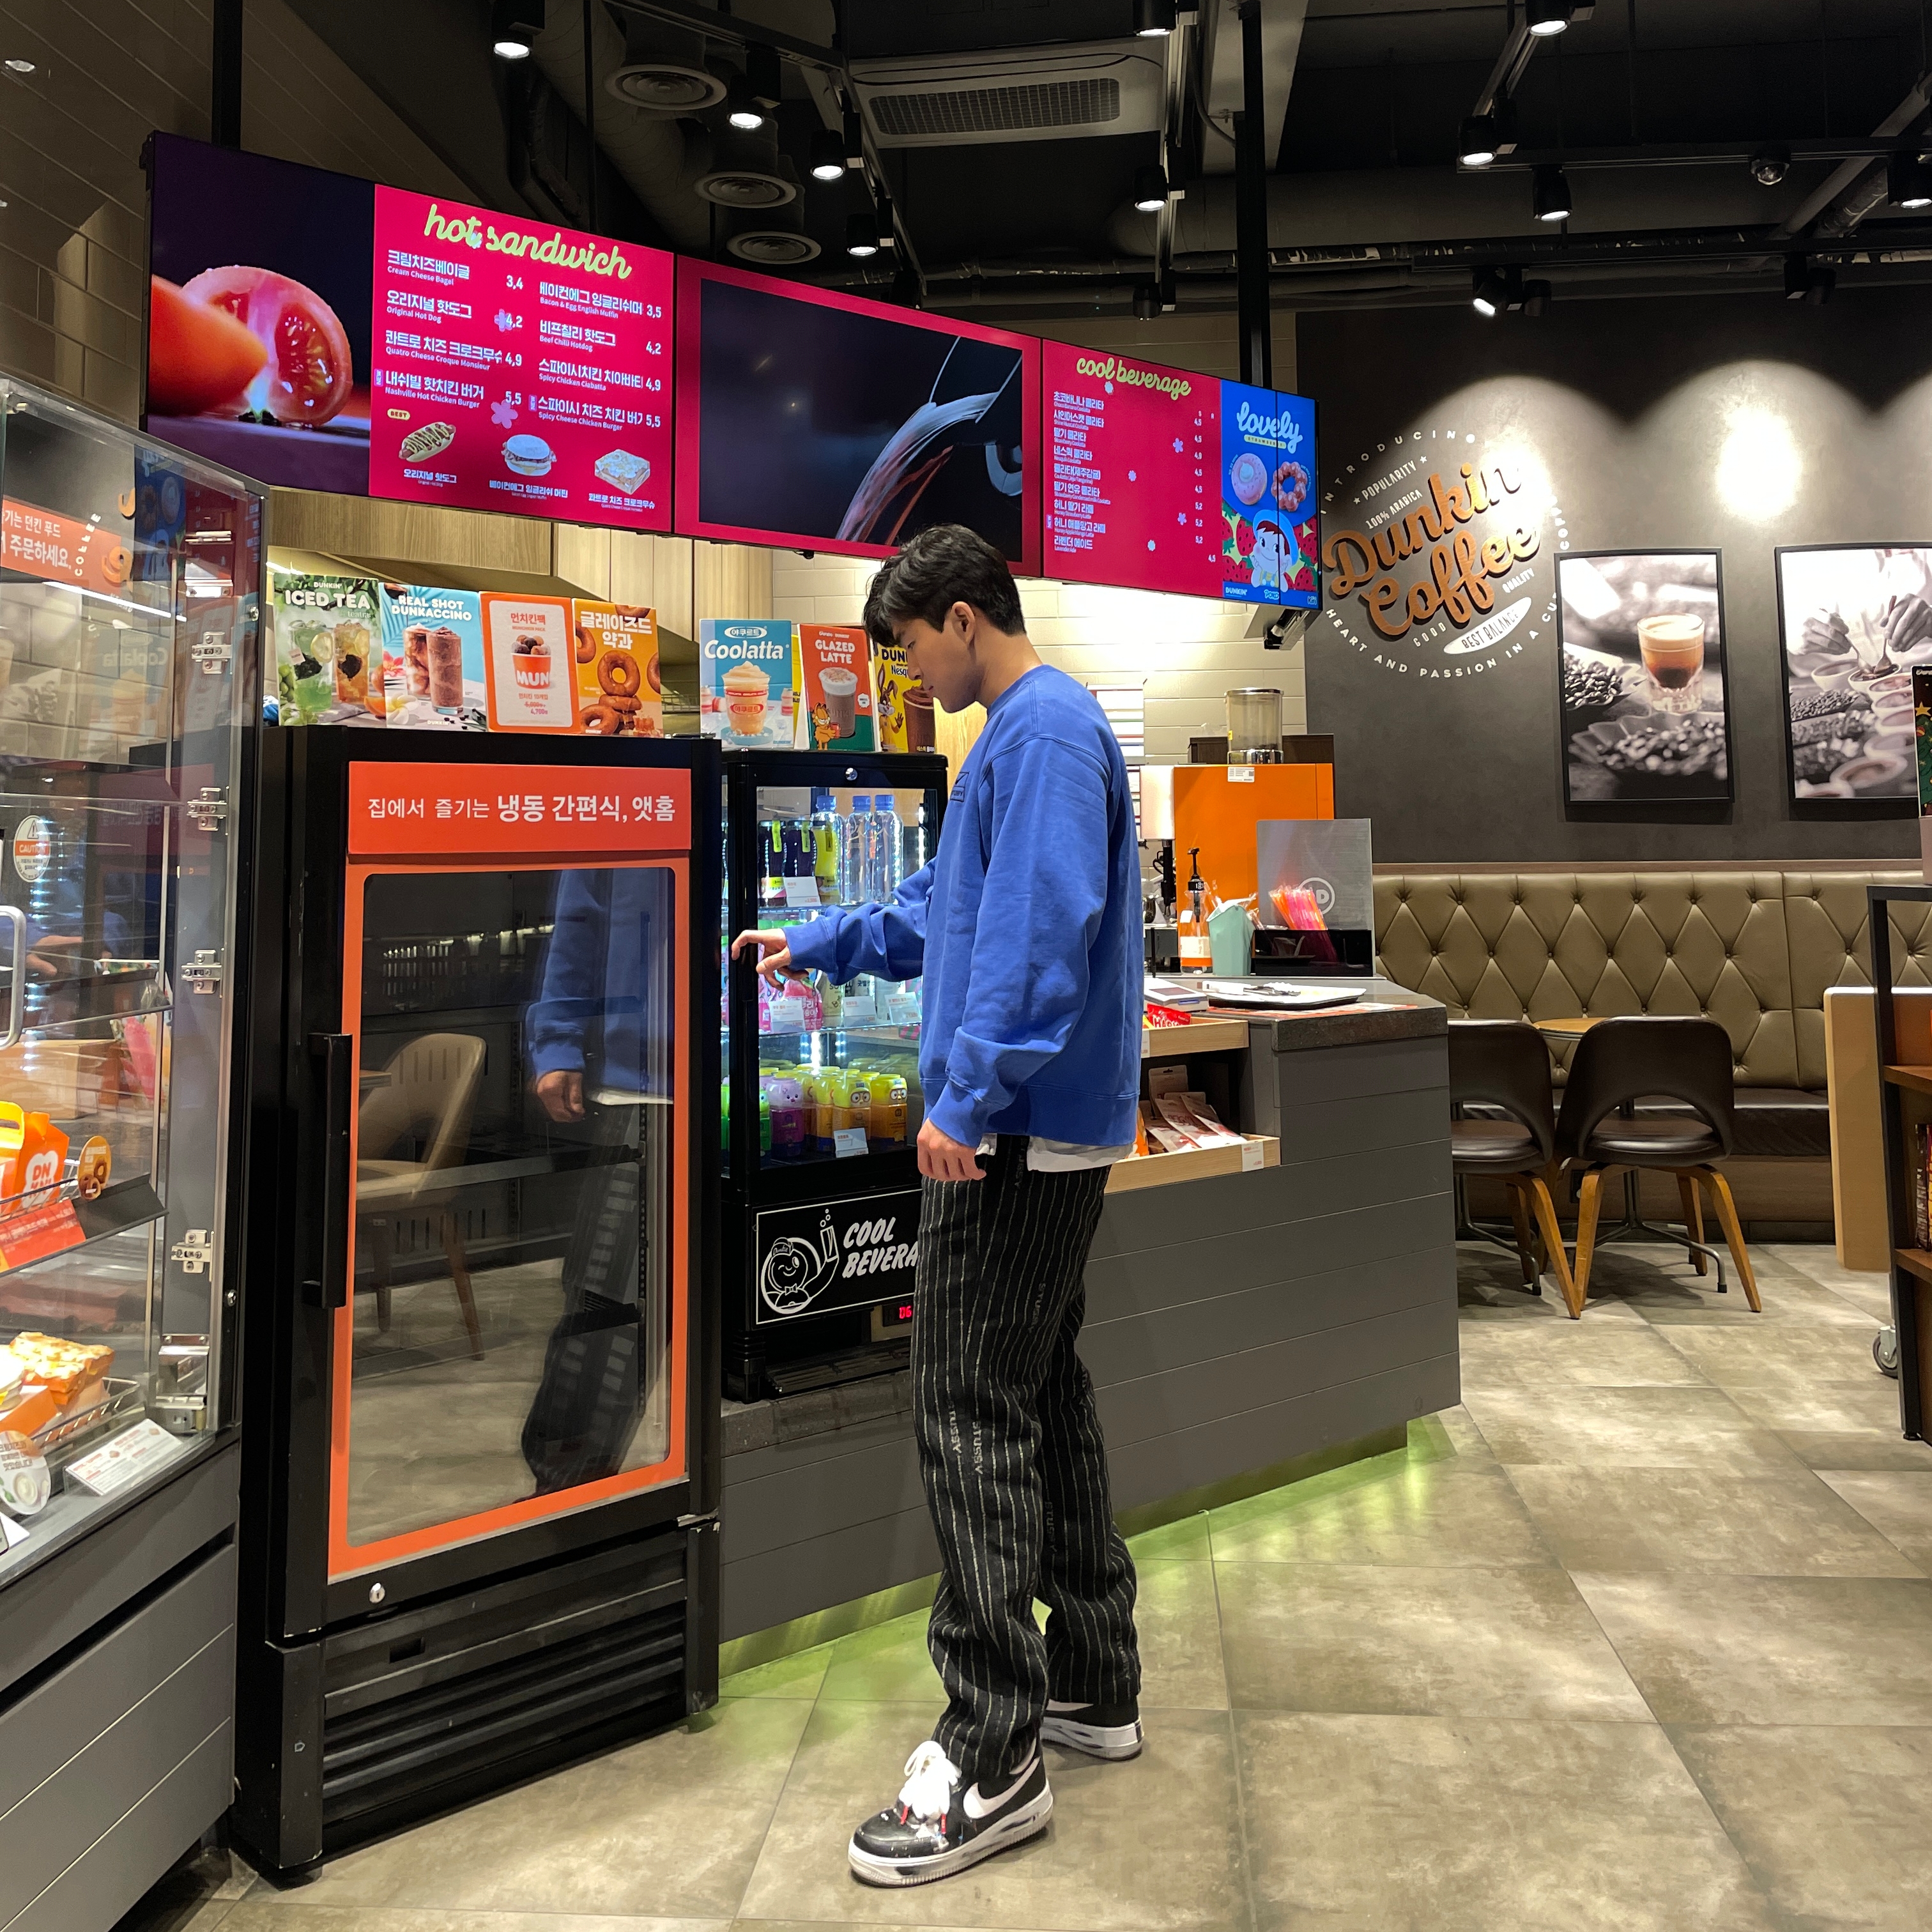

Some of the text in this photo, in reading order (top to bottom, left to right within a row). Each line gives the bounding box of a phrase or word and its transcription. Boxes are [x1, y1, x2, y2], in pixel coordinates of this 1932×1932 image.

[424, 204, 632, 279] hot sandwich
[388, 249, 470, 280] 크림치즈베이글
[387, 266, 454, 286] Cream Cheese Bagel
[506, 275, 523, 289] 3,4
[387, 289, 472, 319] 오리지널 핫도그
[540, 297, 558, 306] Bacon
[565, 302, 576, 312] Egg
[578, 304, 599, 314] English
[600, 309, 618, 319] Muffin
[647, 304, 661, 318] 3,5
[387, 306, 441, 324] Original Hot Dog
[505, 314, 523, 328] 4,2
[385, 330, 421, 349] 콰트로
[424, 336, 447, 353] 치즈
[540, 319, 616, 346] 비프칠리 핫도그
[540, 335, 553, 344] Beef
[571, 341, 593, 353] Hotdog
[646, 341, 661, 355] 4,2
[385, 346, 490, 371] Quatro Cheese Croque Monsieur
[505, 353, 523, 367] 4,9
[539, 358, 602, 382] 스파이시치킨
[539, 373, 556, 383] Spicy
[556, 376, 580, 387] Chicken
[1077, 357, 1192, 400] cool beverage
[386, 371, 421, 390] 내쉬빌
[424, 376, 459, 395] 핫치킨
[461, 383, 484, 400] 버거
[646, 377, 661, 391] 4,9
[385, 387, 480, 409] Nashville Hot Chicken Burger
[505, 391, 522, 406] 5,5
[538, 396, 625, 422] 스파이시 치즈 치킨
[539, 411, 623, 431] Spicy Cheese Chicken Burger
[646, 414, 661, 428] 5,5
[1237, 401, 1303, 454] lovely
[1361, 460, 1417, 500] POPULARITY
[1054, 498, 1066, 510] 허니
[1365, 489, 1423, 529] 100% ARABICA
[2, 510, 61, 538] 기는 던킨 푸드
[1054, 517, 1066, 528] 허니
[10, 534, 72, 570] 주문하세요.
[1361, 528, 1541, 636] Coffee
[285, 590, 371, 610] ICED TEA
[398, 595, 464, 610] REAL SHOT
[1413, 567, 1535, 647] GOOD QUALITY
[391, 605, 472, 621] DUNKACCINO
[510, 613, 546, 625] 먼치킨팩
[580, 610, 652, 634] 글레이즈드
[731, 628, 760, 636] 야쿠르트
[1461, 610, 1519, 649] BEST BALANCE
[602, 632, 632, 650] 약과
[704, 640, 784, 660] Coolatta
[815, 639, 855, 652] GLAZED
[1326, 608, 1368, 652] HEART
[1374, 654, 1408, 673] AND
[1420, 657, 1497, 678] PASSION
[1505, 642, 1523, 659] IN
[1529, 630, 1539, 640] A
[820, 651, 852, 664] LATTE
[882, 648, 908, 662] DUN
[516, 670, 549, 686] MUN
[368, 798, 425, 819] 집에서
[434, 798, 489, 819] 즐기는
[497, 794, 546, 823] 냉동
[631, 795, 676, 822] 앳홈
[843, 1216, 896, 1248] COOL
[842, 1241, 918, 1278] BEVERA
[972, 1421, 983, 1475] STUSSY
